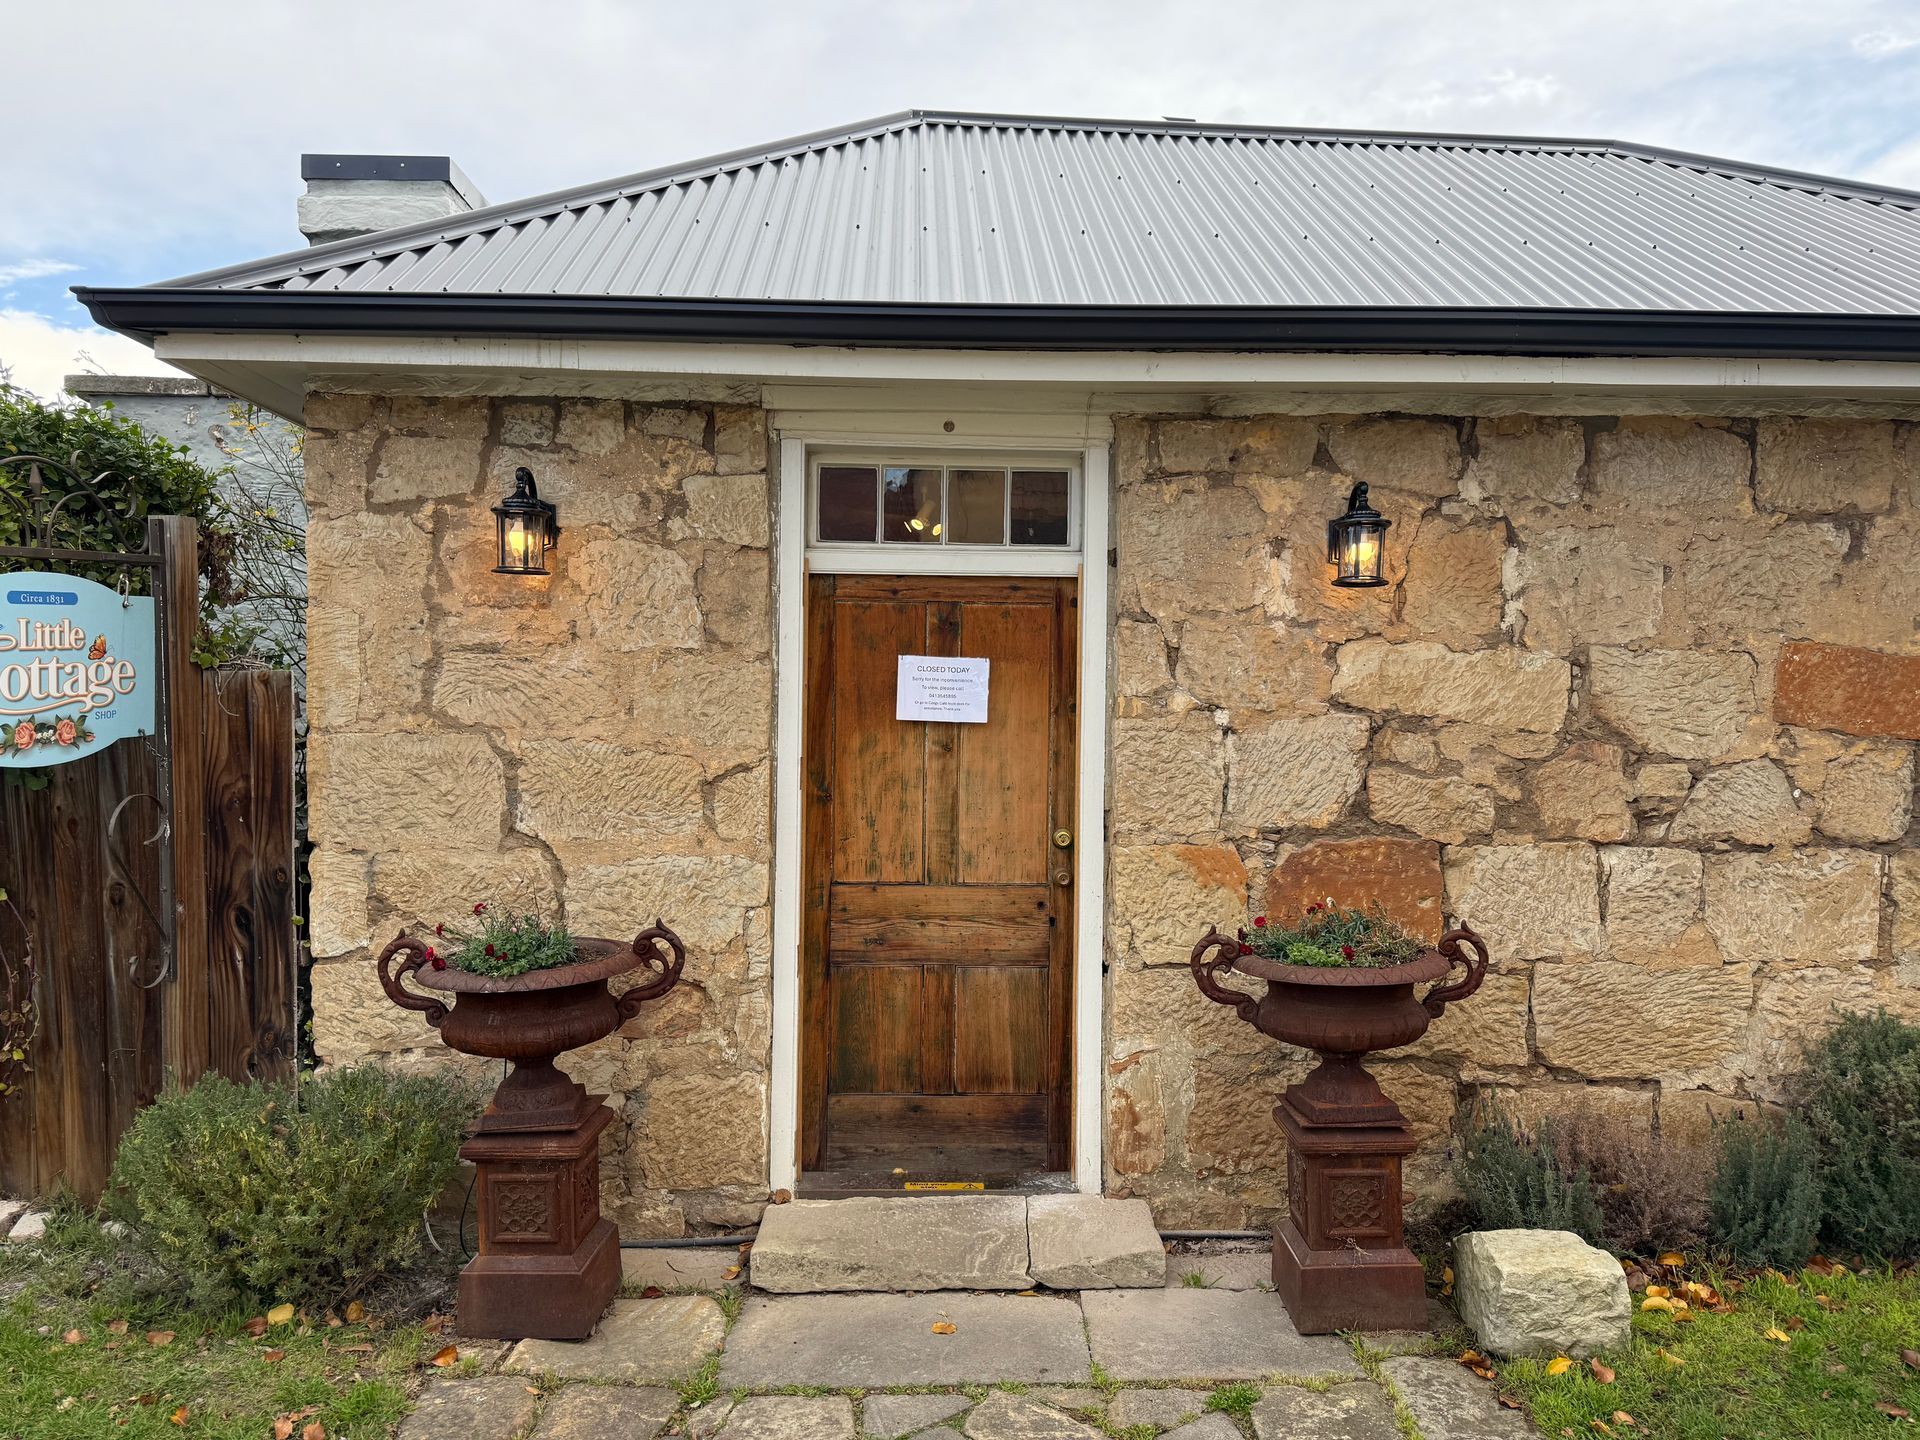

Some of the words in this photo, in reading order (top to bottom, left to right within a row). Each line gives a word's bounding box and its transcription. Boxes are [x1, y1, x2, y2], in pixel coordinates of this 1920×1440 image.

[20, 593, 43, 602] Circa
[46, 594, 64, 604] 1831
[16, 617, 86, 651] Little
[917, 665, 945, 673] CLOSED
[947, 666, 970, 674] TODAY
[0, 656, 136, 712] ottage
[95, 710, 117, 720] SHOP
